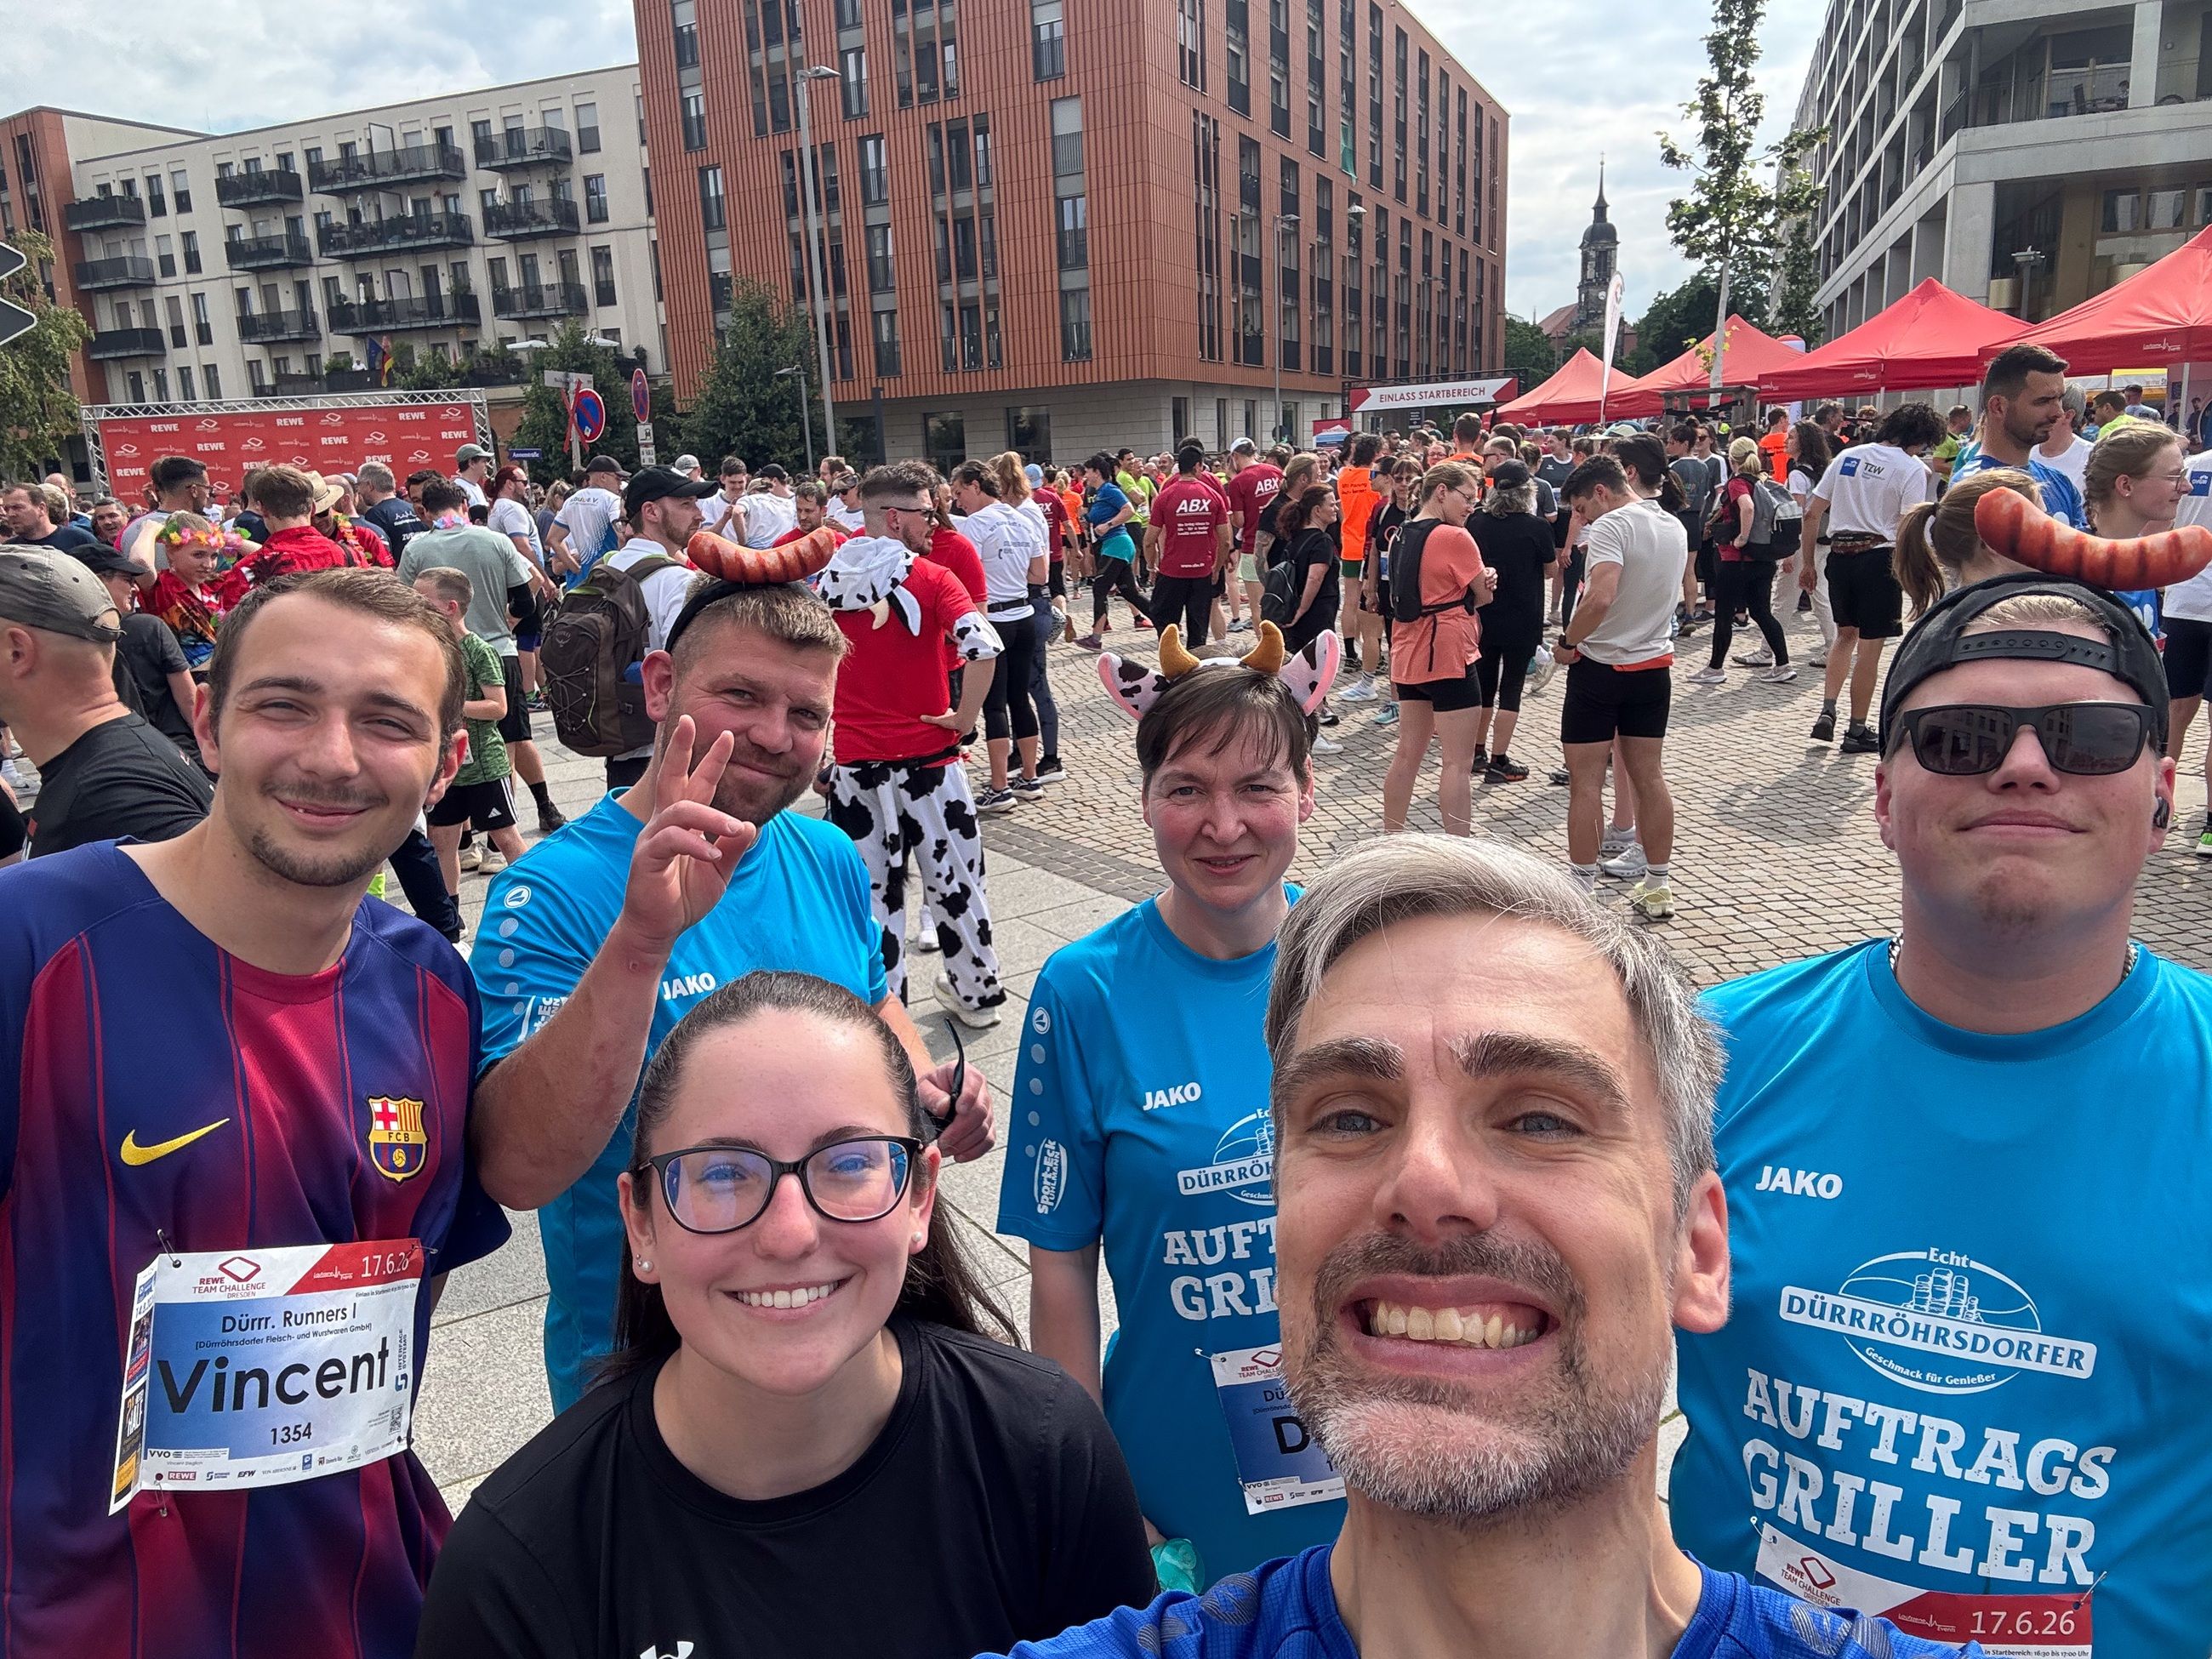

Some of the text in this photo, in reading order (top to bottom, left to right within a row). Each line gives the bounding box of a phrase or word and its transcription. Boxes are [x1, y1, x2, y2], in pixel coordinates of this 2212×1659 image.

[1379, 387, 1485, 403] EINLASS STARTBEREICH
[276, 418, 305, 426] REWE
[398, 412, 426, 420] REWE
[151, 424, 180, 433] REWE
[441, 430, 468, 440] REWE
[197, 442, 225, 452] REWE
[321, 436, 348, 445] REWE
[242, 460, 271, 470] REWE
[365, 454, 392, 464] REWE
[117, 468, 145, 477] REWE
[1864, 462, 1884, 475] TZW
[1255, 477, 1279, 494] ABX
[1176, 499, 1211, 513] ABX
[663, 972, 716, 1001] JAKO
[1143, 1082, 1201, 1111] JAKO
[1257, 1109, 1270, 1119] Ec
[388, 1132, 410, 1142] FCB
[1037, 1139, 1056, 1214] Sport-Eck
[1183, 1160, 1272, 1190] DÜRRRÖ
[1755, 1166, 1843, 1200] JAKO
[1240, 1190, 1273, 1200] Geschma
[1163, 1216, 1278, 1266] AUFT
[362, 1251, 411, 1278] 17.6.26
[1928, 1247, 1970, 1268] Echt
[192, 1282, 265, 1294] TEAM CHALLENGE
[199, 1277, 225, 1286] REWE
[1171, 1267, 1279, 1320] GRI
[221, 1314, 276, 1333] Dürrr.
[283, 1307, 348, 1328] Runners
[297, 1331, 311, 1340] und
[1787, 1294, 2085, 1371] DÜRRRÖHRSDORFER
[1865, 1346, 1996, 1386] Geschmack für Genießer
[157, 1336, 389, 1414] Vincent
[271, 1422, 312, 1445] 1354
[1742, 1366, 2117, 1500] AUFTRAGS
[149, 1450, 171, 1458] VVO
[1742, 1438, 2095, 1587] GRILLER
[1787, 1563, 1804, 1580] REWE
[1782, 1569, 1842, 1606] TEAM CHALLENGE
[1804, 1592, 1830, 1607] DRESDEN
[1970, 1611, 2075, 1636] 17.6.26
